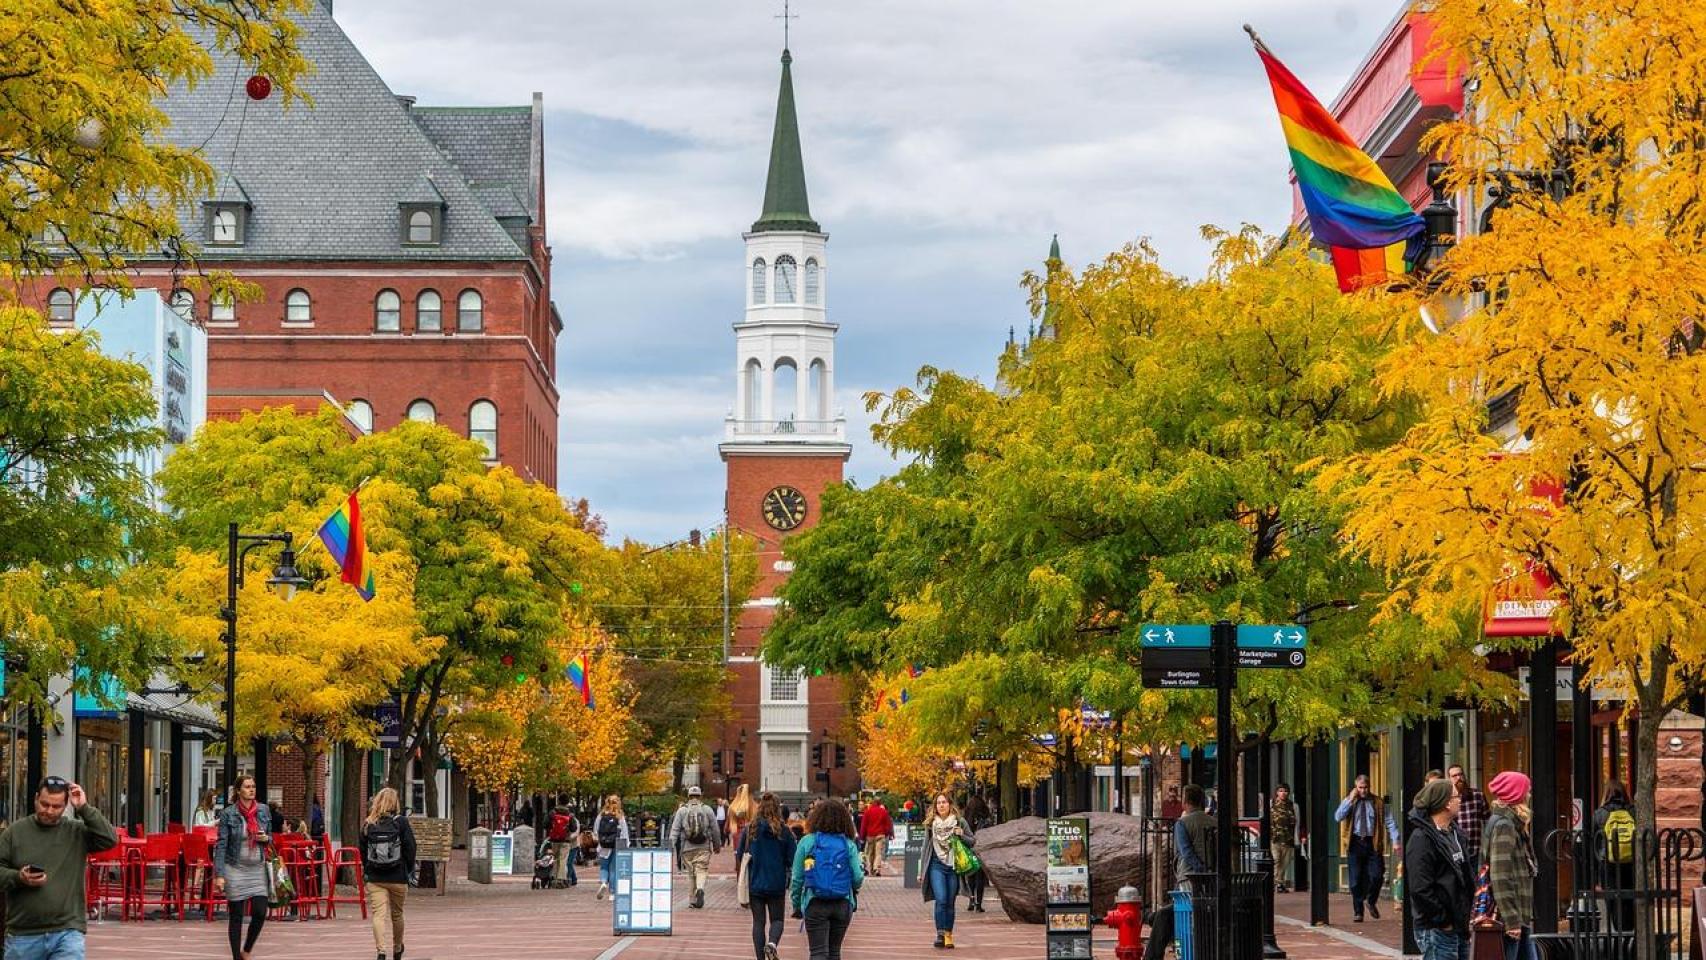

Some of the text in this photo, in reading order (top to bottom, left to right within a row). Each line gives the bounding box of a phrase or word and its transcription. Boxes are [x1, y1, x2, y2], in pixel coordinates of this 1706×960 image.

[1239, 650, 1277, 659] Marketplace
[1167, 671, 1200, 679] Burlington
[1049, 825, 1081, 835] True
